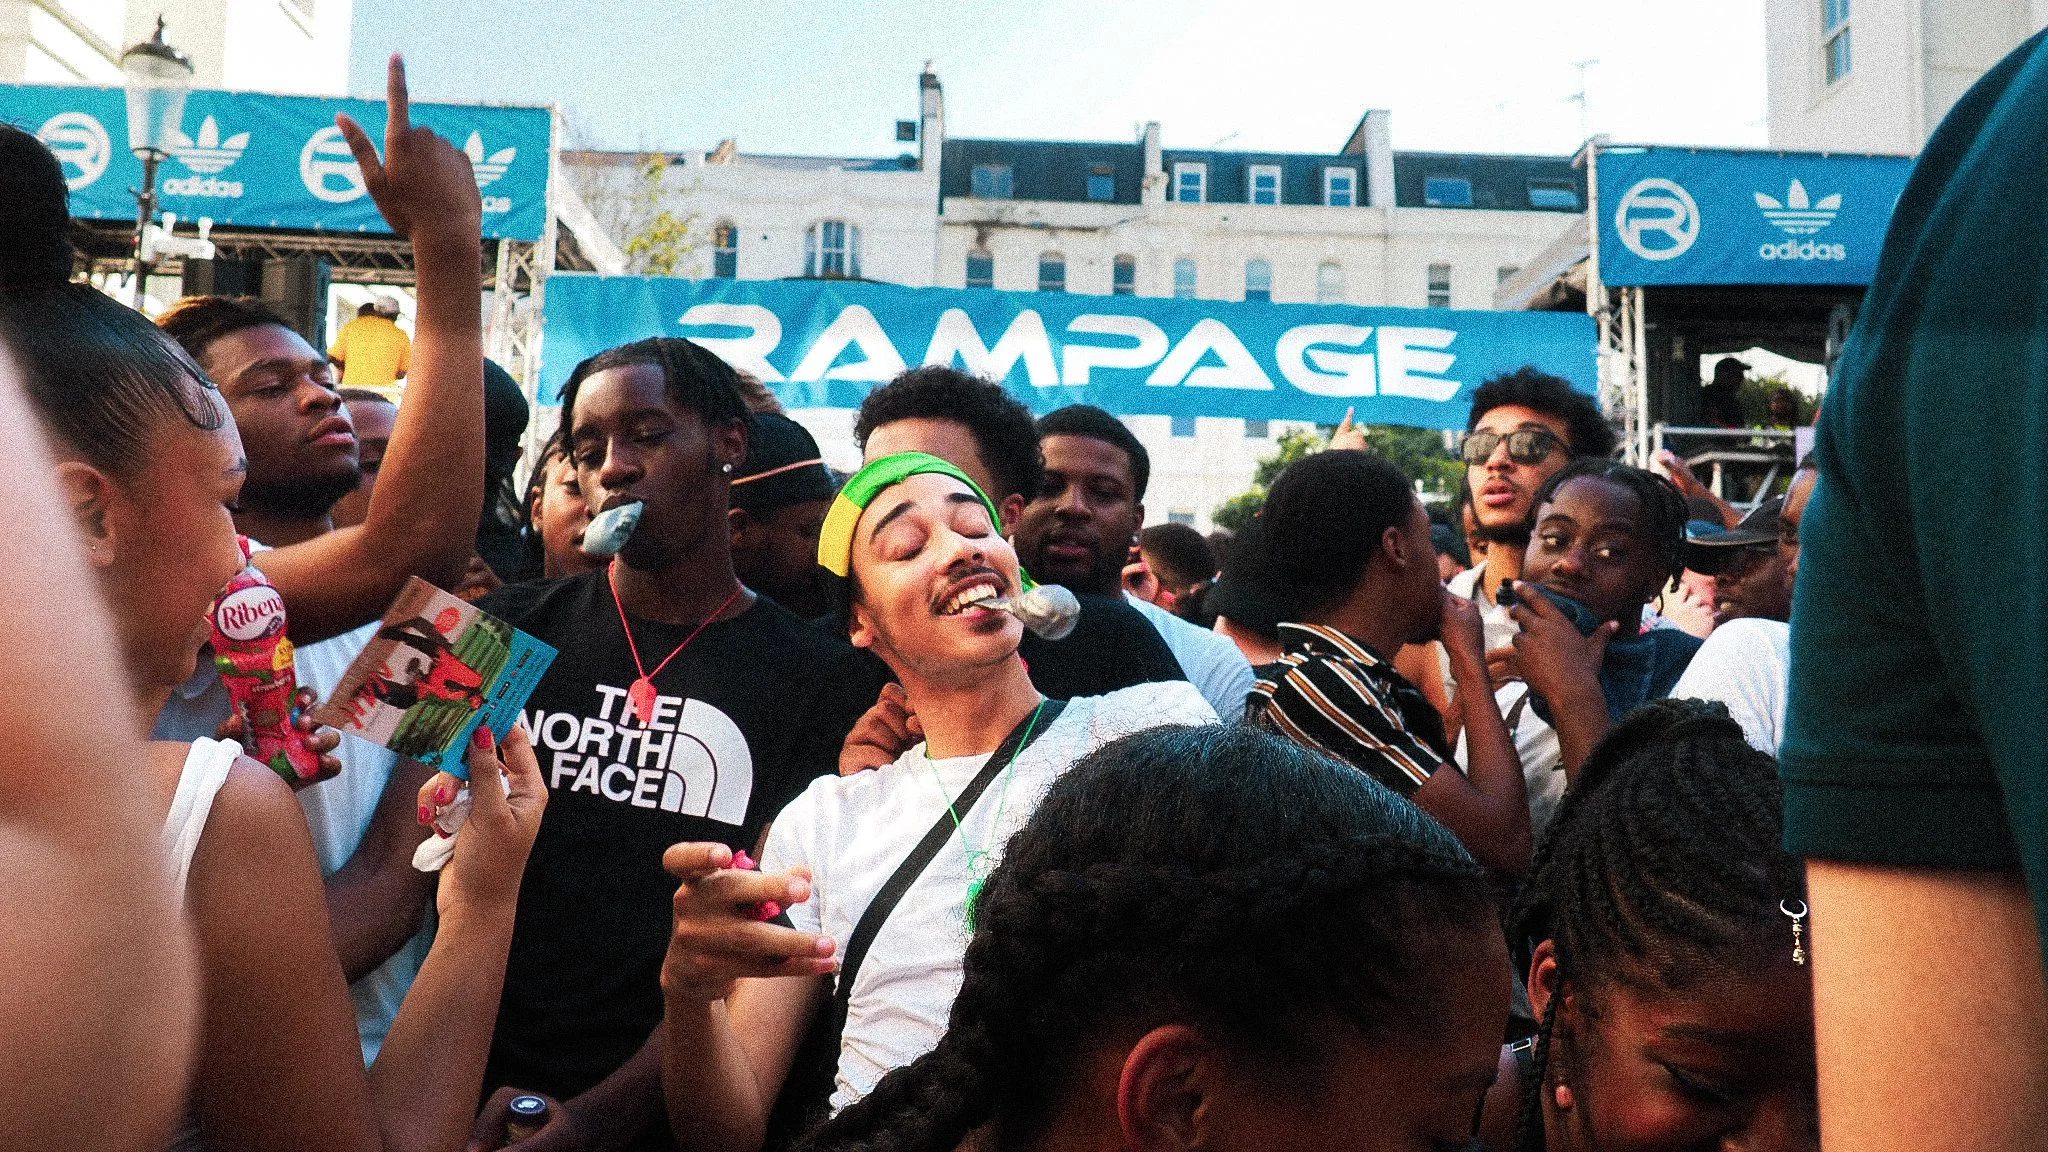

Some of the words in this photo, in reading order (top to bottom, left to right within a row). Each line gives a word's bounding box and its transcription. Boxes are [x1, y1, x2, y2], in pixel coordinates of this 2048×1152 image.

[164, 176, 244, 198] adidas
[1759, 239, 1846, 260] adidas
[678, 302, 1463, 402] RAMPAGE
[519, 709, 673, 770] NORTH
[551, 751, 663, 808] FACE
